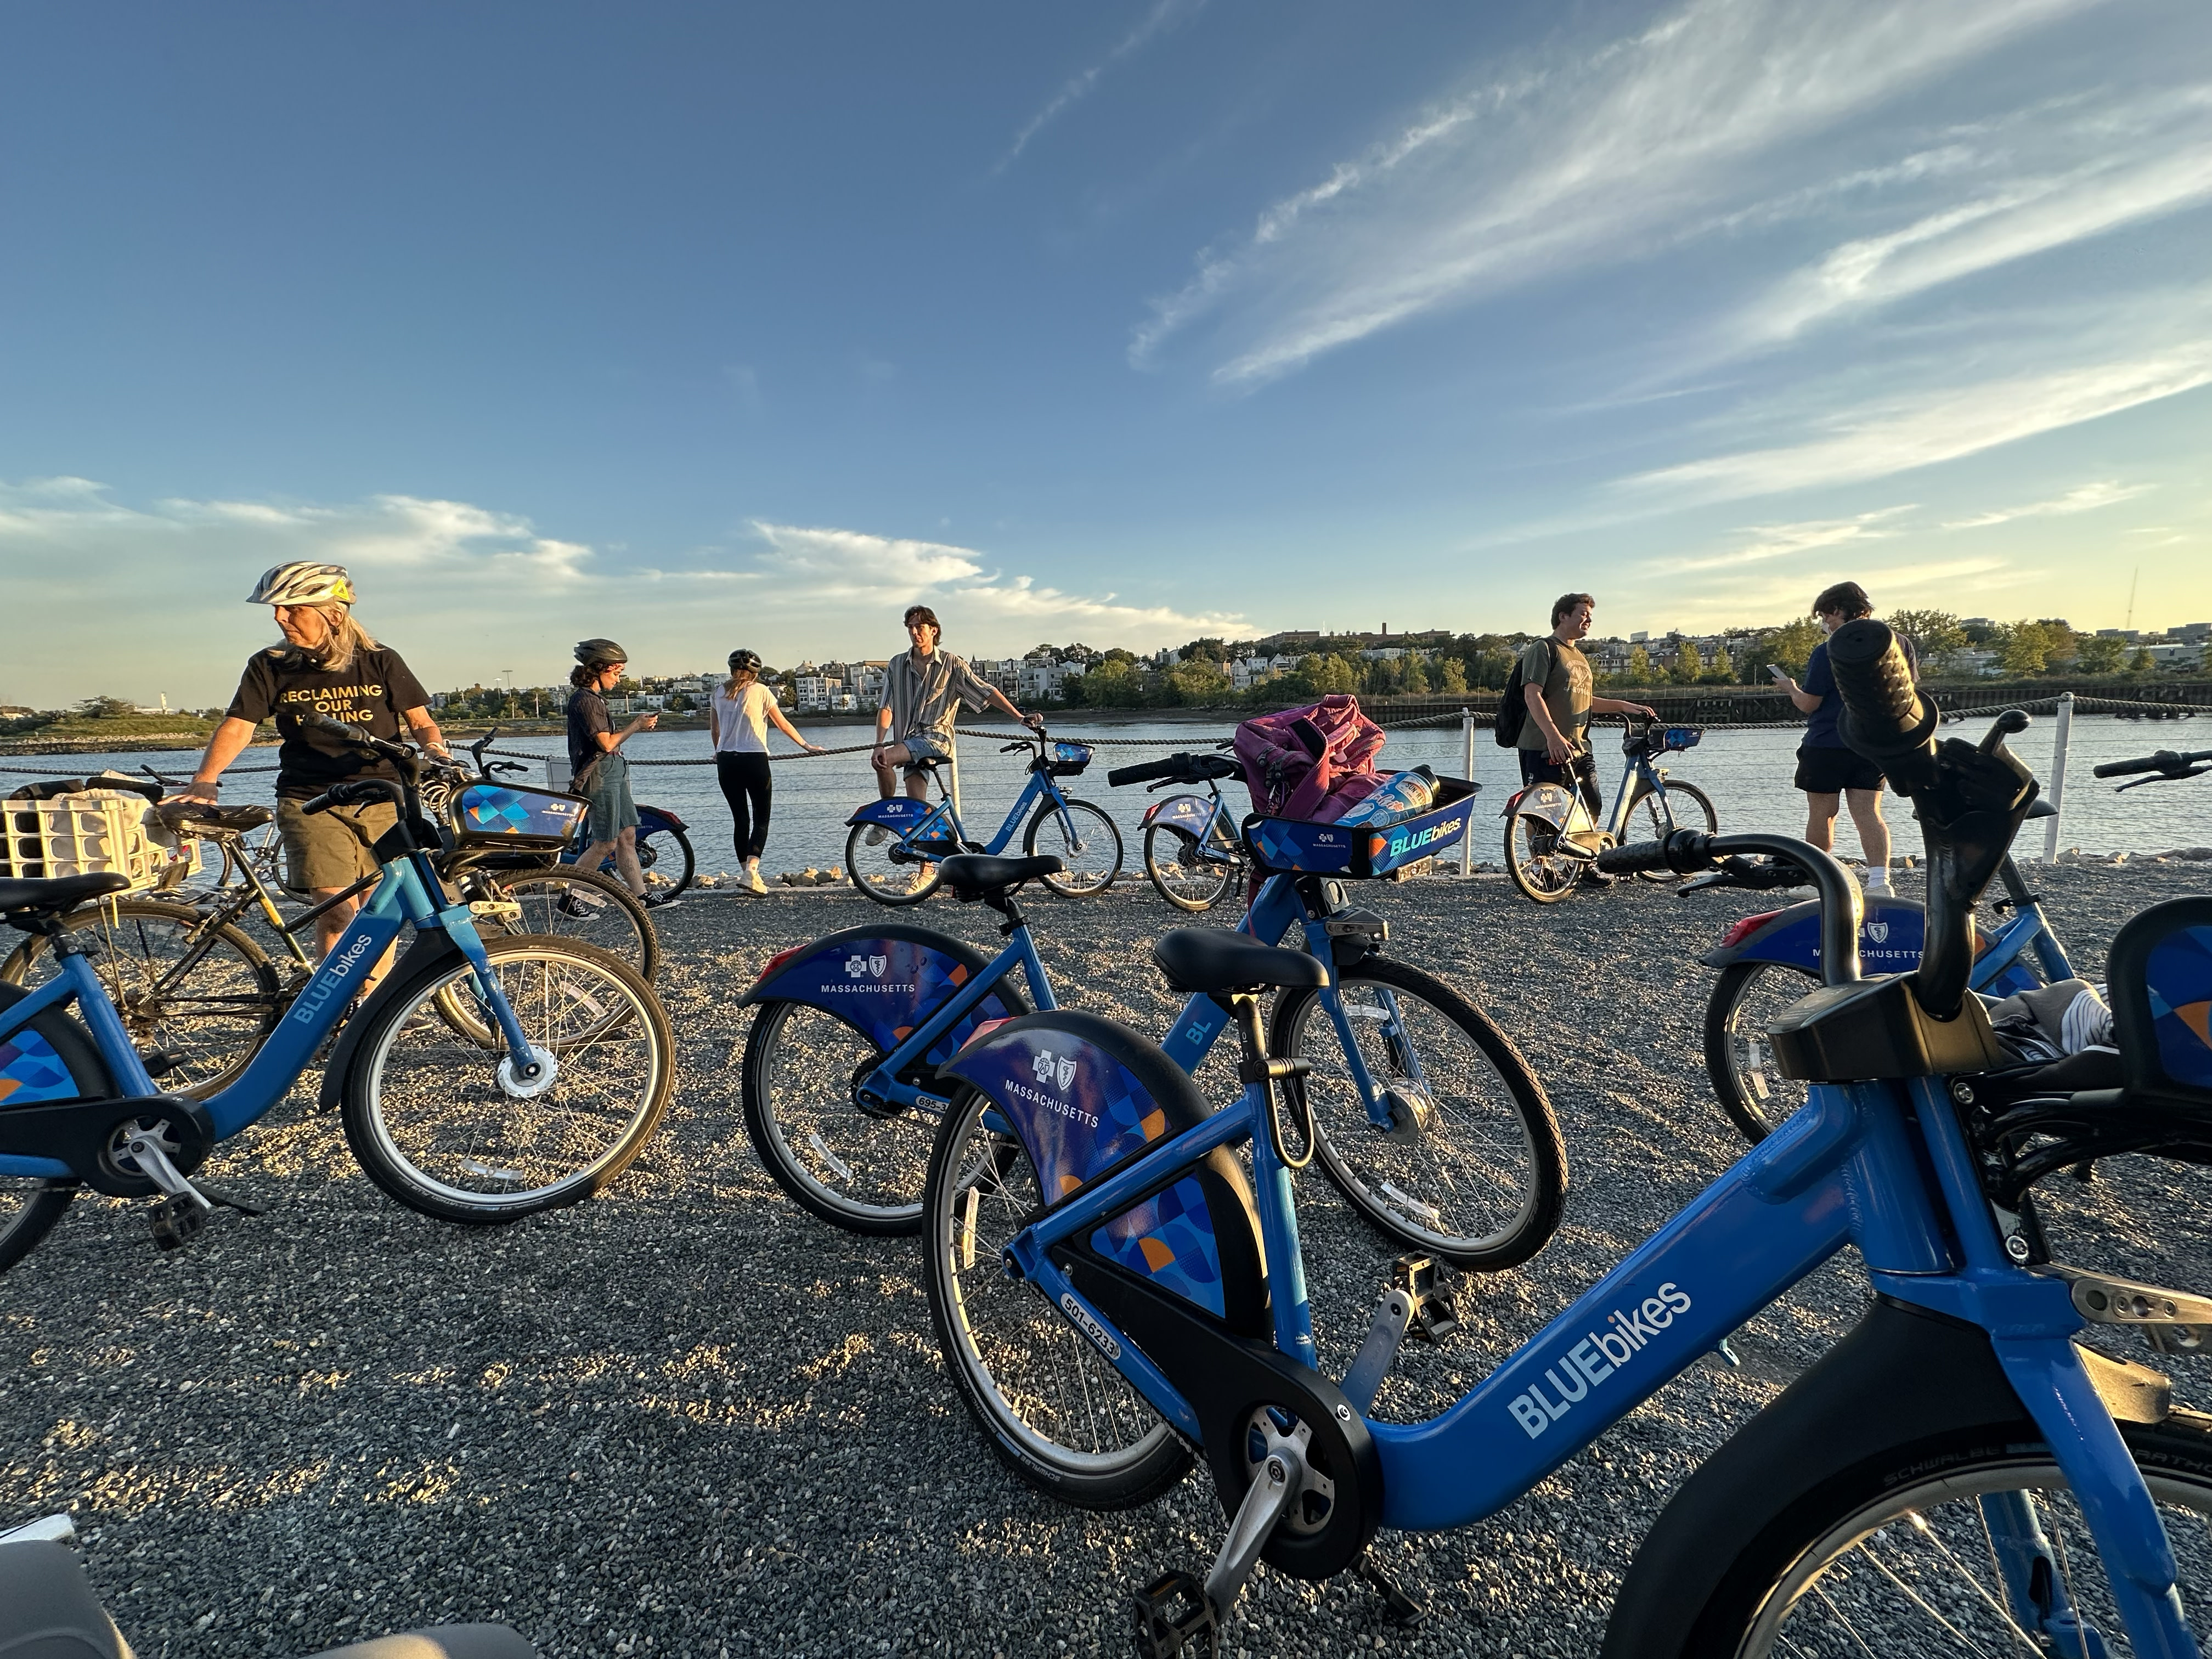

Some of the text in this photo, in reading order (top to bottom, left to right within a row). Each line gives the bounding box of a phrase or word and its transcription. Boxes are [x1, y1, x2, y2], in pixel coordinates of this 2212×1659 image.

[280, 684, 383, 703] RECLAIMING
[315, 699, 353, 712] OUR
[296, 709, 374, 726] HLING
[1390, 817, 1461, 857] BLUEbikes
[1813, 949, 1924, 958] MCHUSETTS
[294, 934, 372, 1024] BLUEbikes
[821, 984, 915, 992] MASSACHUSETTS
[1005, 1079, 1098, 1128] MASSACHUSETTS
[1064, 1298, 1115, 1355] 501-6233
[1507, 1283, 1691, 1440] BLUEbikes
[1020, 1455, 1061, 1482] SCHWALBE
[1883, 1444, 2001, 1486] SCHWALBE
